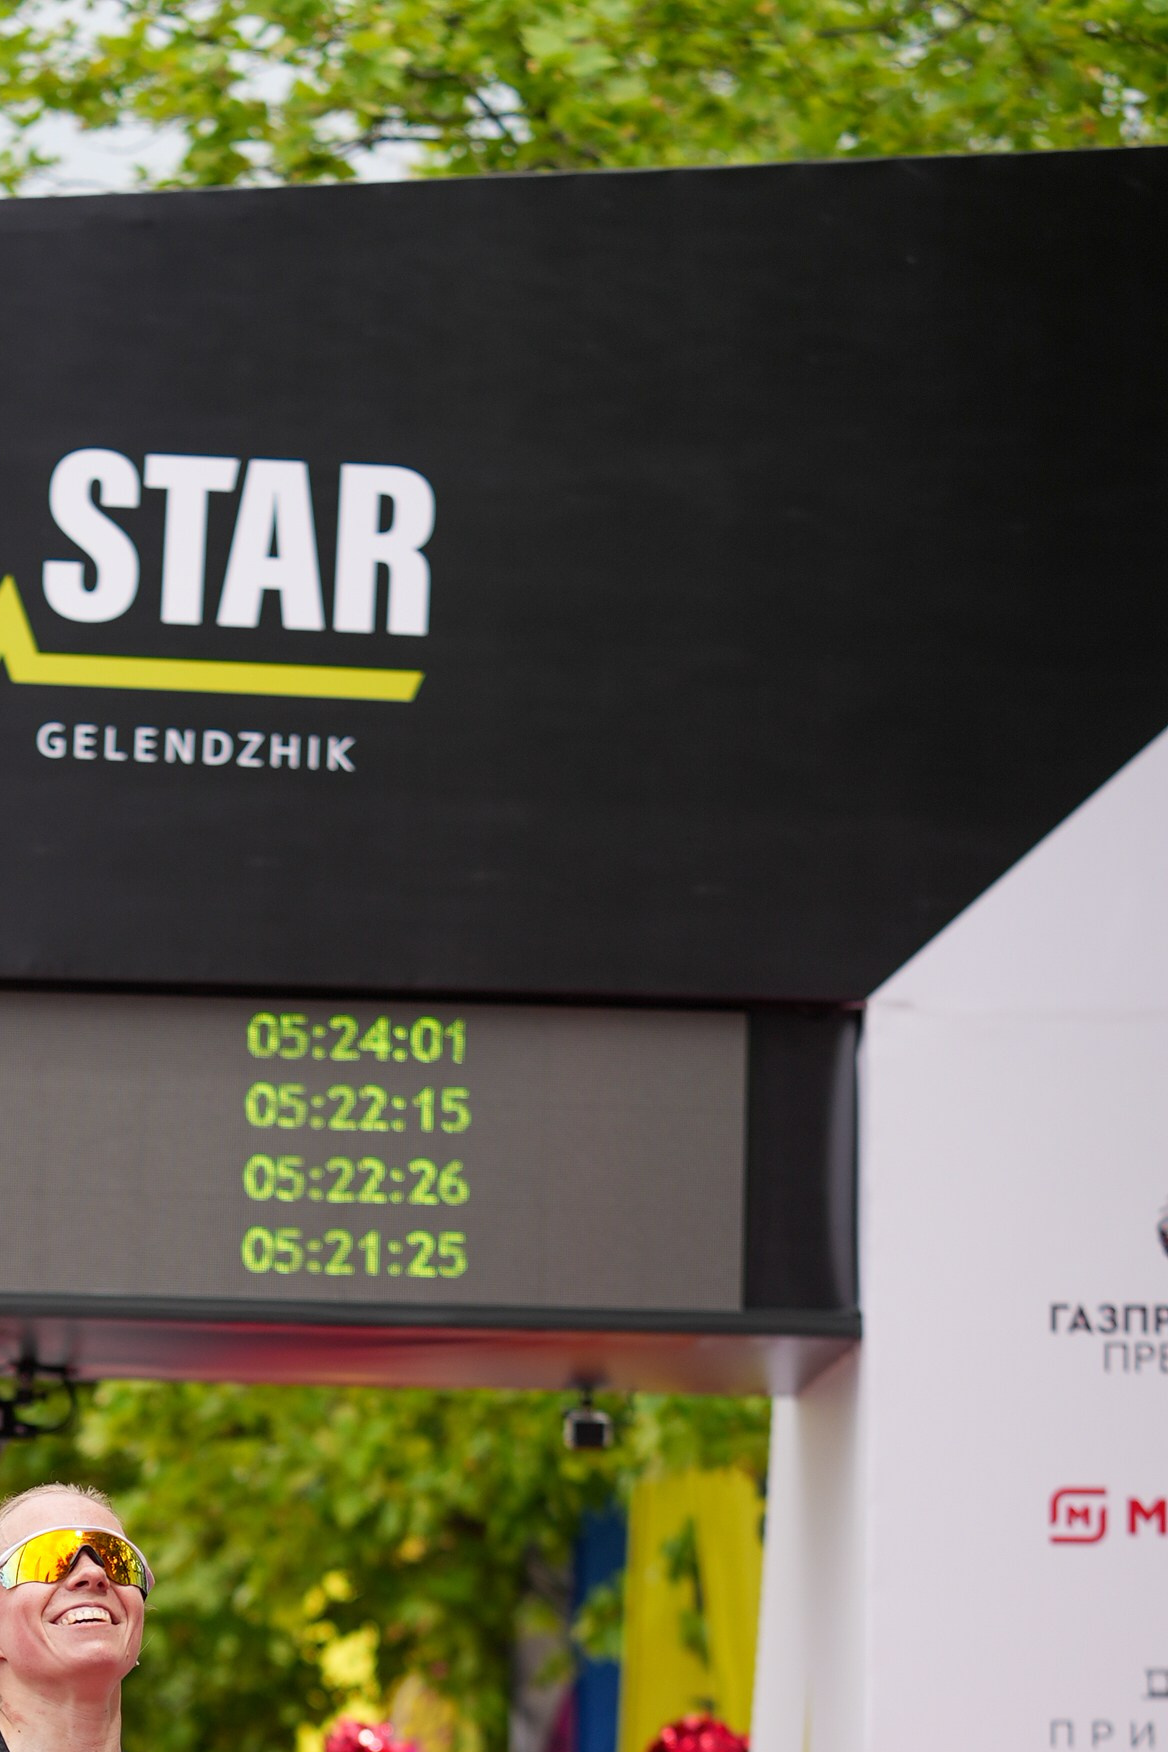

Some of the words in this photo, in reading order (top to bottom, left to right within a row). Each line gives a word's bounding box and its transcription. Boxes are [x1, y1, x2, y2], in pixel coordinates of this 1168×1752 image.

[42, 448, 434, 635] STAR
[35, 722, 356, 772] GELENDZHIK
[247, 1011, 466, 1064] 05:24:01
[245, 1081, 472, 1133] 05:22:15
[242, 1153, 471, 1206] 05:22:26
[241, 1226, 469, 1278] 05:21:25
[1049, 1719, 1155, 1748] ПРИ
